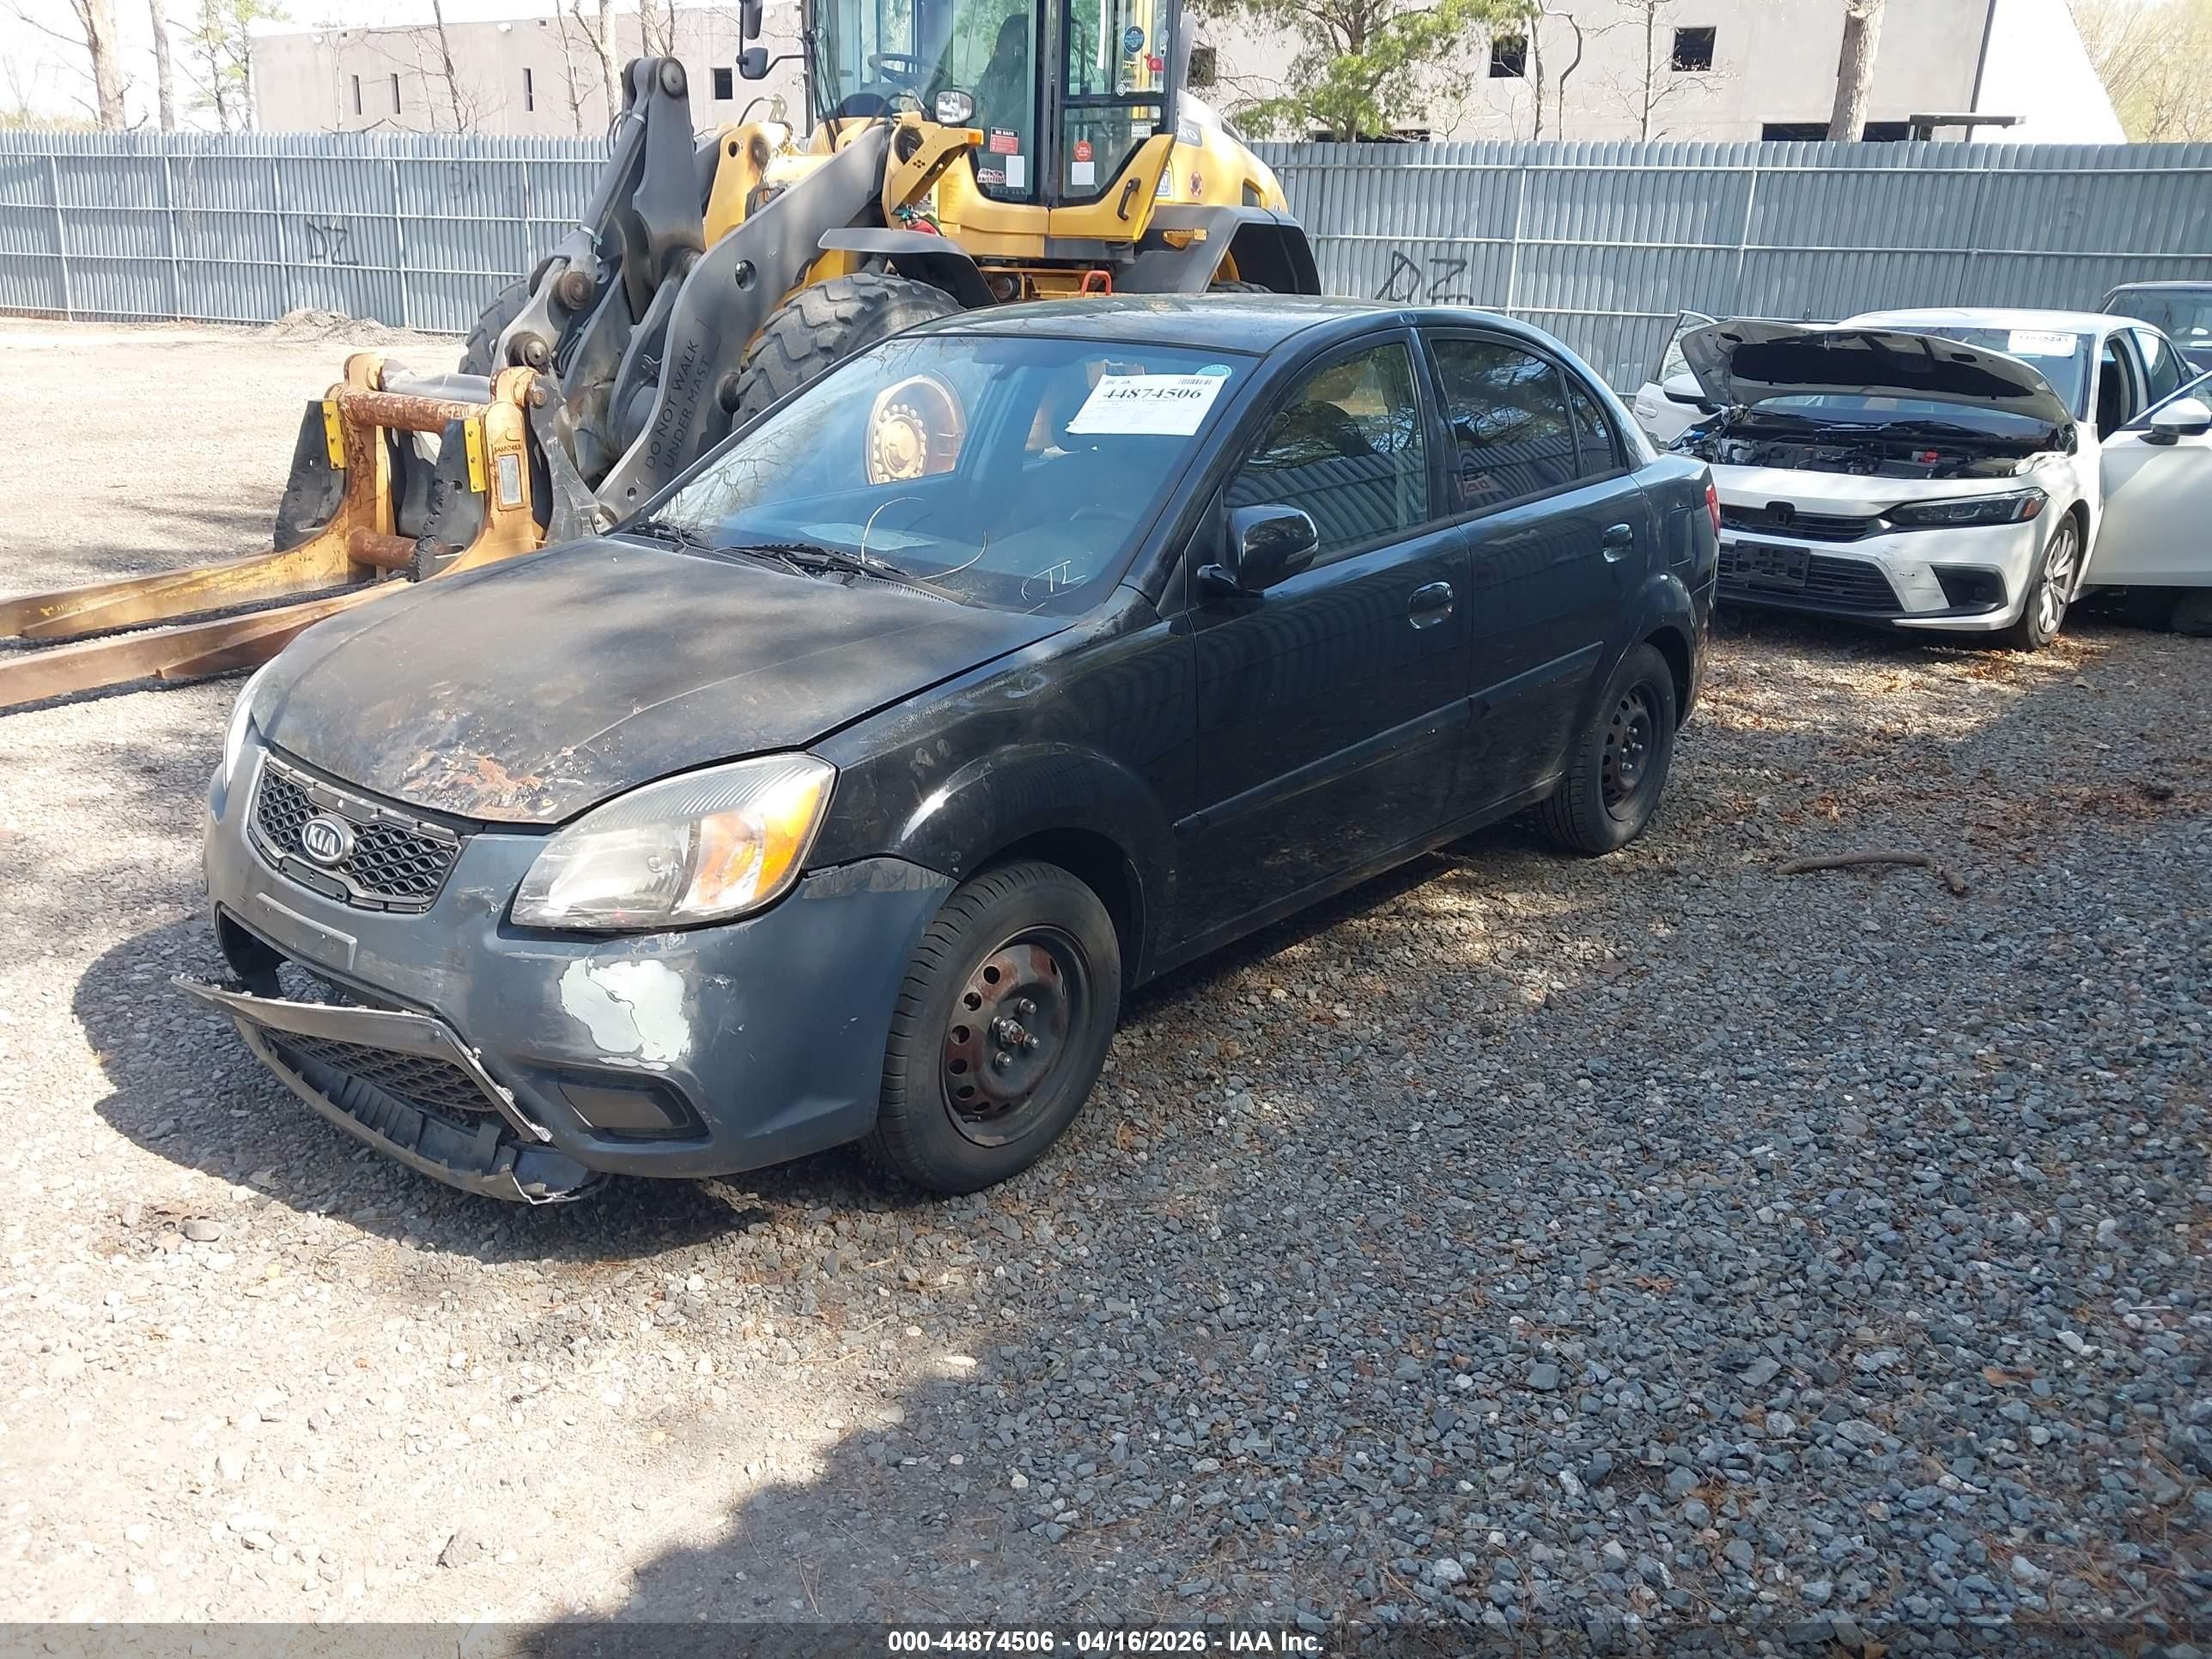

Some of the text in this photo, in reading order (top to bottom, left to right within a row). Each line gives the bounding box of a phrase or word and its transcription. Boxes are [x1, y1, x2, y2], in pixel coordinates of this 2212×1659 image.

[646, 339, 700, 469] DO NOT WALK
[663, 355, 710, 468] UNDER MAST
[1103, 388, 1203, 398] 44874506
[307, 824, 336, 856] KIA
